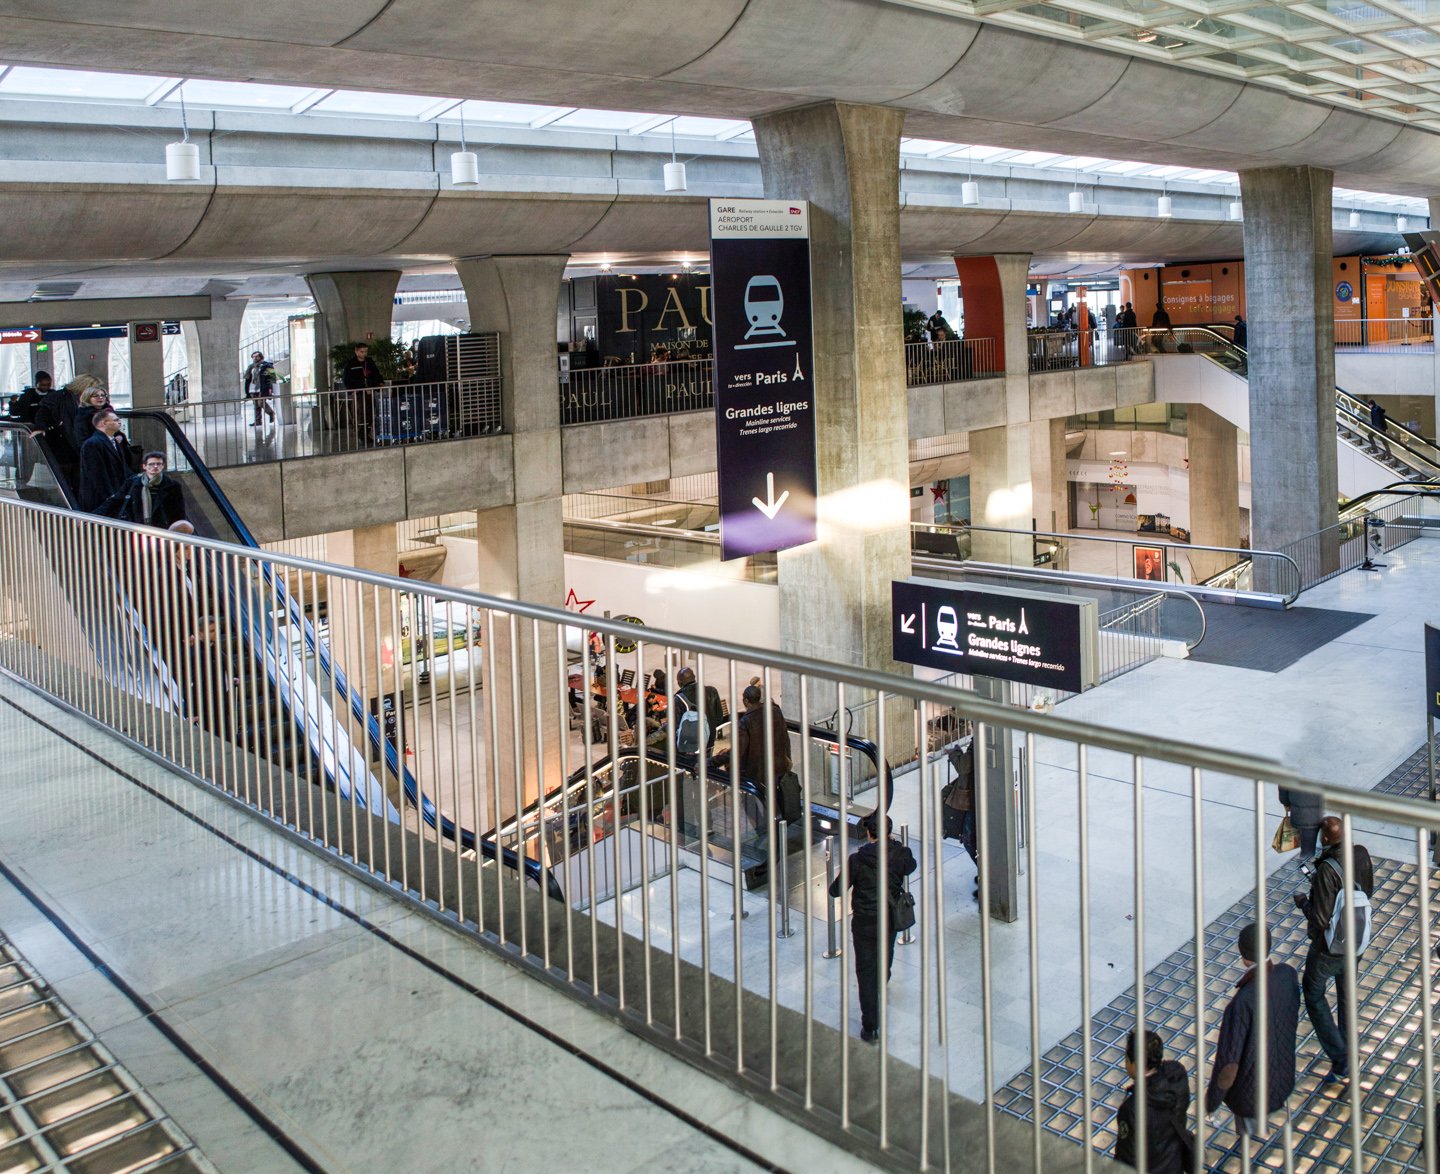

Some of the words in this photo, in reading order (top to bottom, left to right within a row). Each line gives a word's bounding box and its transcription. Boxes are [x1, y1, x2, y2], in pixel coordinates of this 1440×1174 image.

[717, 206, 736, 214] GARE
[718, 215, 754, 223] AÉROPORT
[1162, 295, 1197, 305] Consignes
[1205, 293, 1235, 303] bagages
[696, 339, 709, 349] DE
[734, 373, 752, 381] vers
[755, 371, 788, 386] Paris
[725, 404, 774, 419] Grandes
[776, 401, 809, 415] lignes
[745, 418, 770, 427] Mainline
[770, 415, 792, 424] services
[758, 425, 773, 434] largo
[773, 422, 798, 431] recorrido
[967, 612, 982, 621] vers
[988, 615, 1016, 632] Paris
[968, 632, 1009, 651] Grandes
[1010, 639, 1041, 657] lignes
[1012, 655, 1028, 665] Trenes
[1029, 659, 1041, 668] largo
[1041, 662, 1065, 671] recorrido
